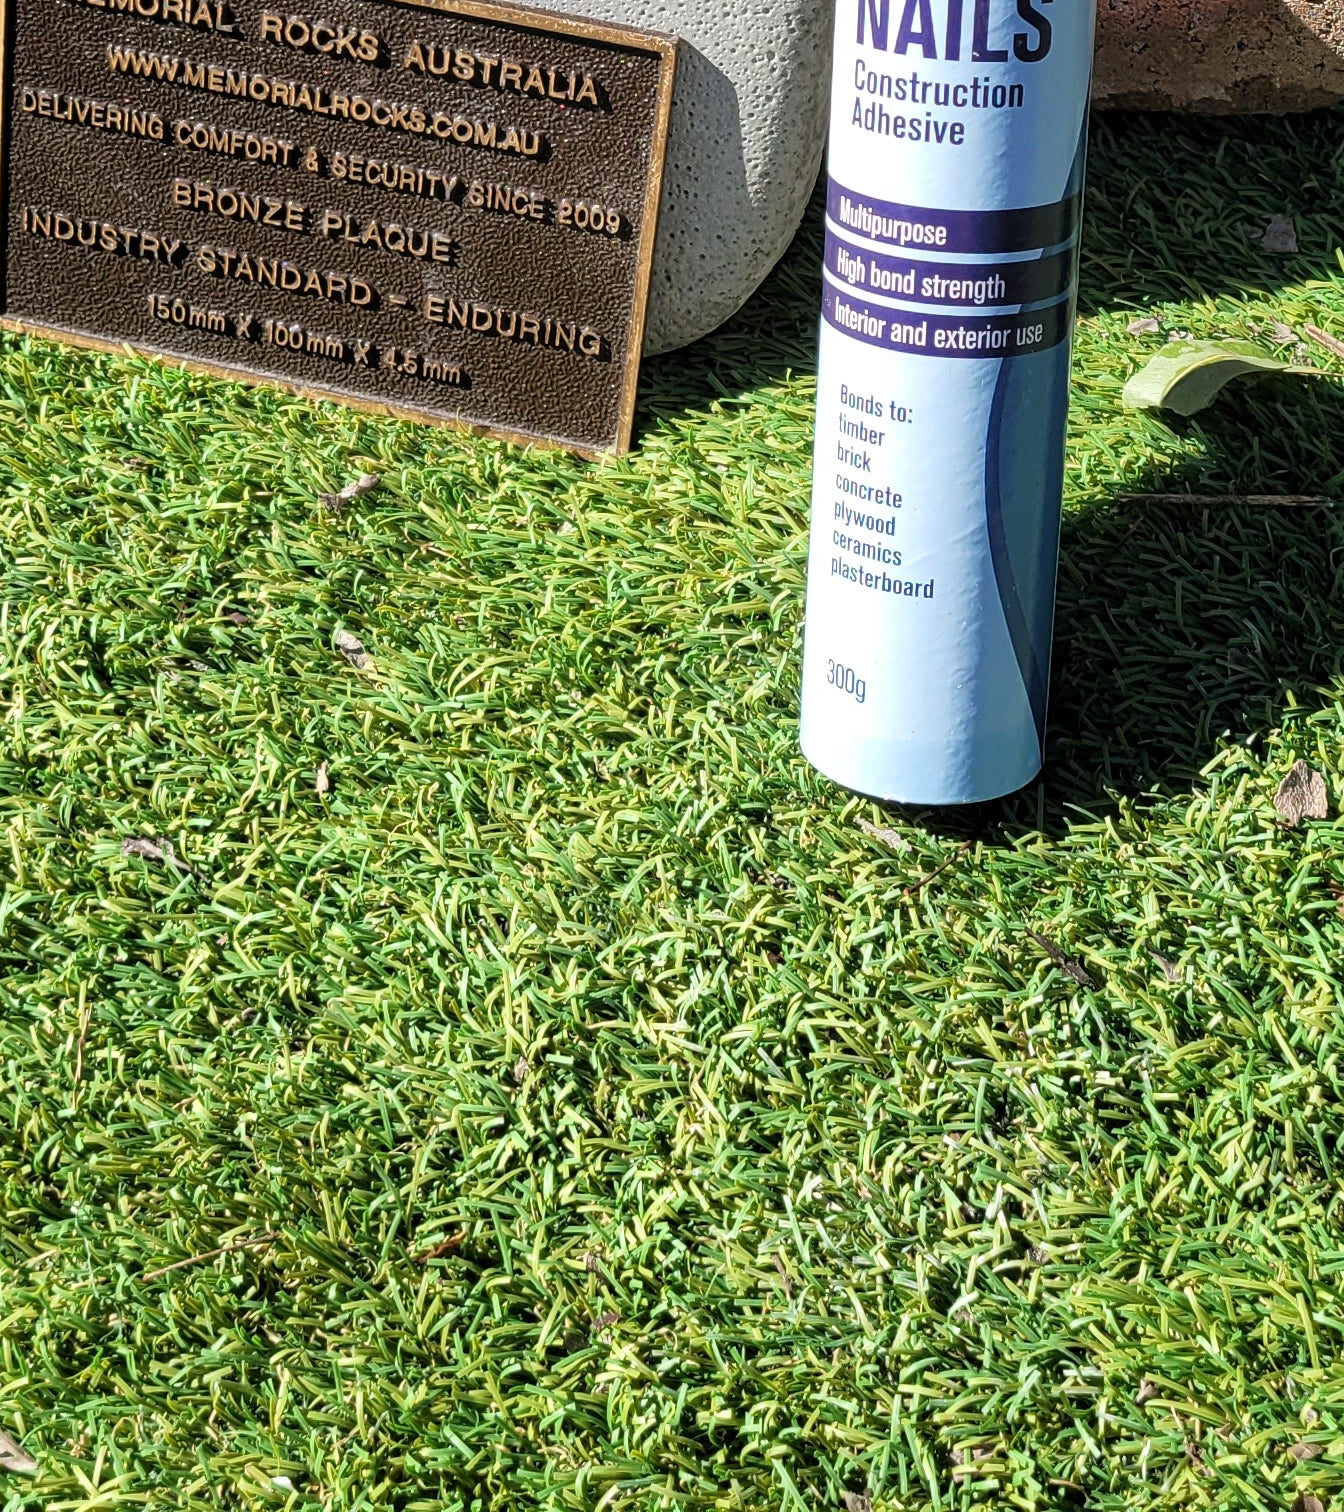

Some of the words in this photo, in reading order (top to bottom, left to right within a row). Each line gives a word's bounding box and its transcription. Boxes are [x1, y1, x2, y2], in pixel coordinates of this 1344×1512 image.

[261, 14, 378, 60] ROCKS
[404, 41, 598, 103] AUSTRALIA
[106, 45, 539, 155] WWW.MEMORIALROCKS.COM.AU
[855, 59, 1024, 108] Construction
[852, 98, 965, 145] Adhesive
[22, 90, 163, 139] DELIVERING
[174, 121, 292, 167] COMFORT
[306, 146, 320, 171] &
[332, 154, 456, 198] SECURITY
[469, 186, 544, 219] SINCE
[557, 203, 621, 235] 2009
[173, 180, 303, 230] BRONZE
[324, 215, 450, 263] PLAQUE
[839, 196, 946, 245] Multipurpose
[24, 210, 179, 263] INDUSTRY
[198, 249, 371, 305] STANDARD
[426, 296, 601, 357] ENDURING
[837, 246, 865, 287] High
[870, 262, 917, 297] bond
[922, 273, 1005, 304] strength
[835, 296, 885, 339] Interior
[890, 315, 928, 347] and
[933, 321, 1011, 349] exterior
[1017, 322, 1043, 346] use
[840, 384, 884, 419] Bonds
[888, 402, 913, 423] to:
[838, 414, 885, 447] timber
[837, 440, 871, 473] brick
[836, 476, 902, 509] concrete
[834, 501, 895, 539] plywood
[833, 530, 902, 566] ceramics
[831, 554, 934, 600] plasterboard
[827, 659, 866, 704] 300g
